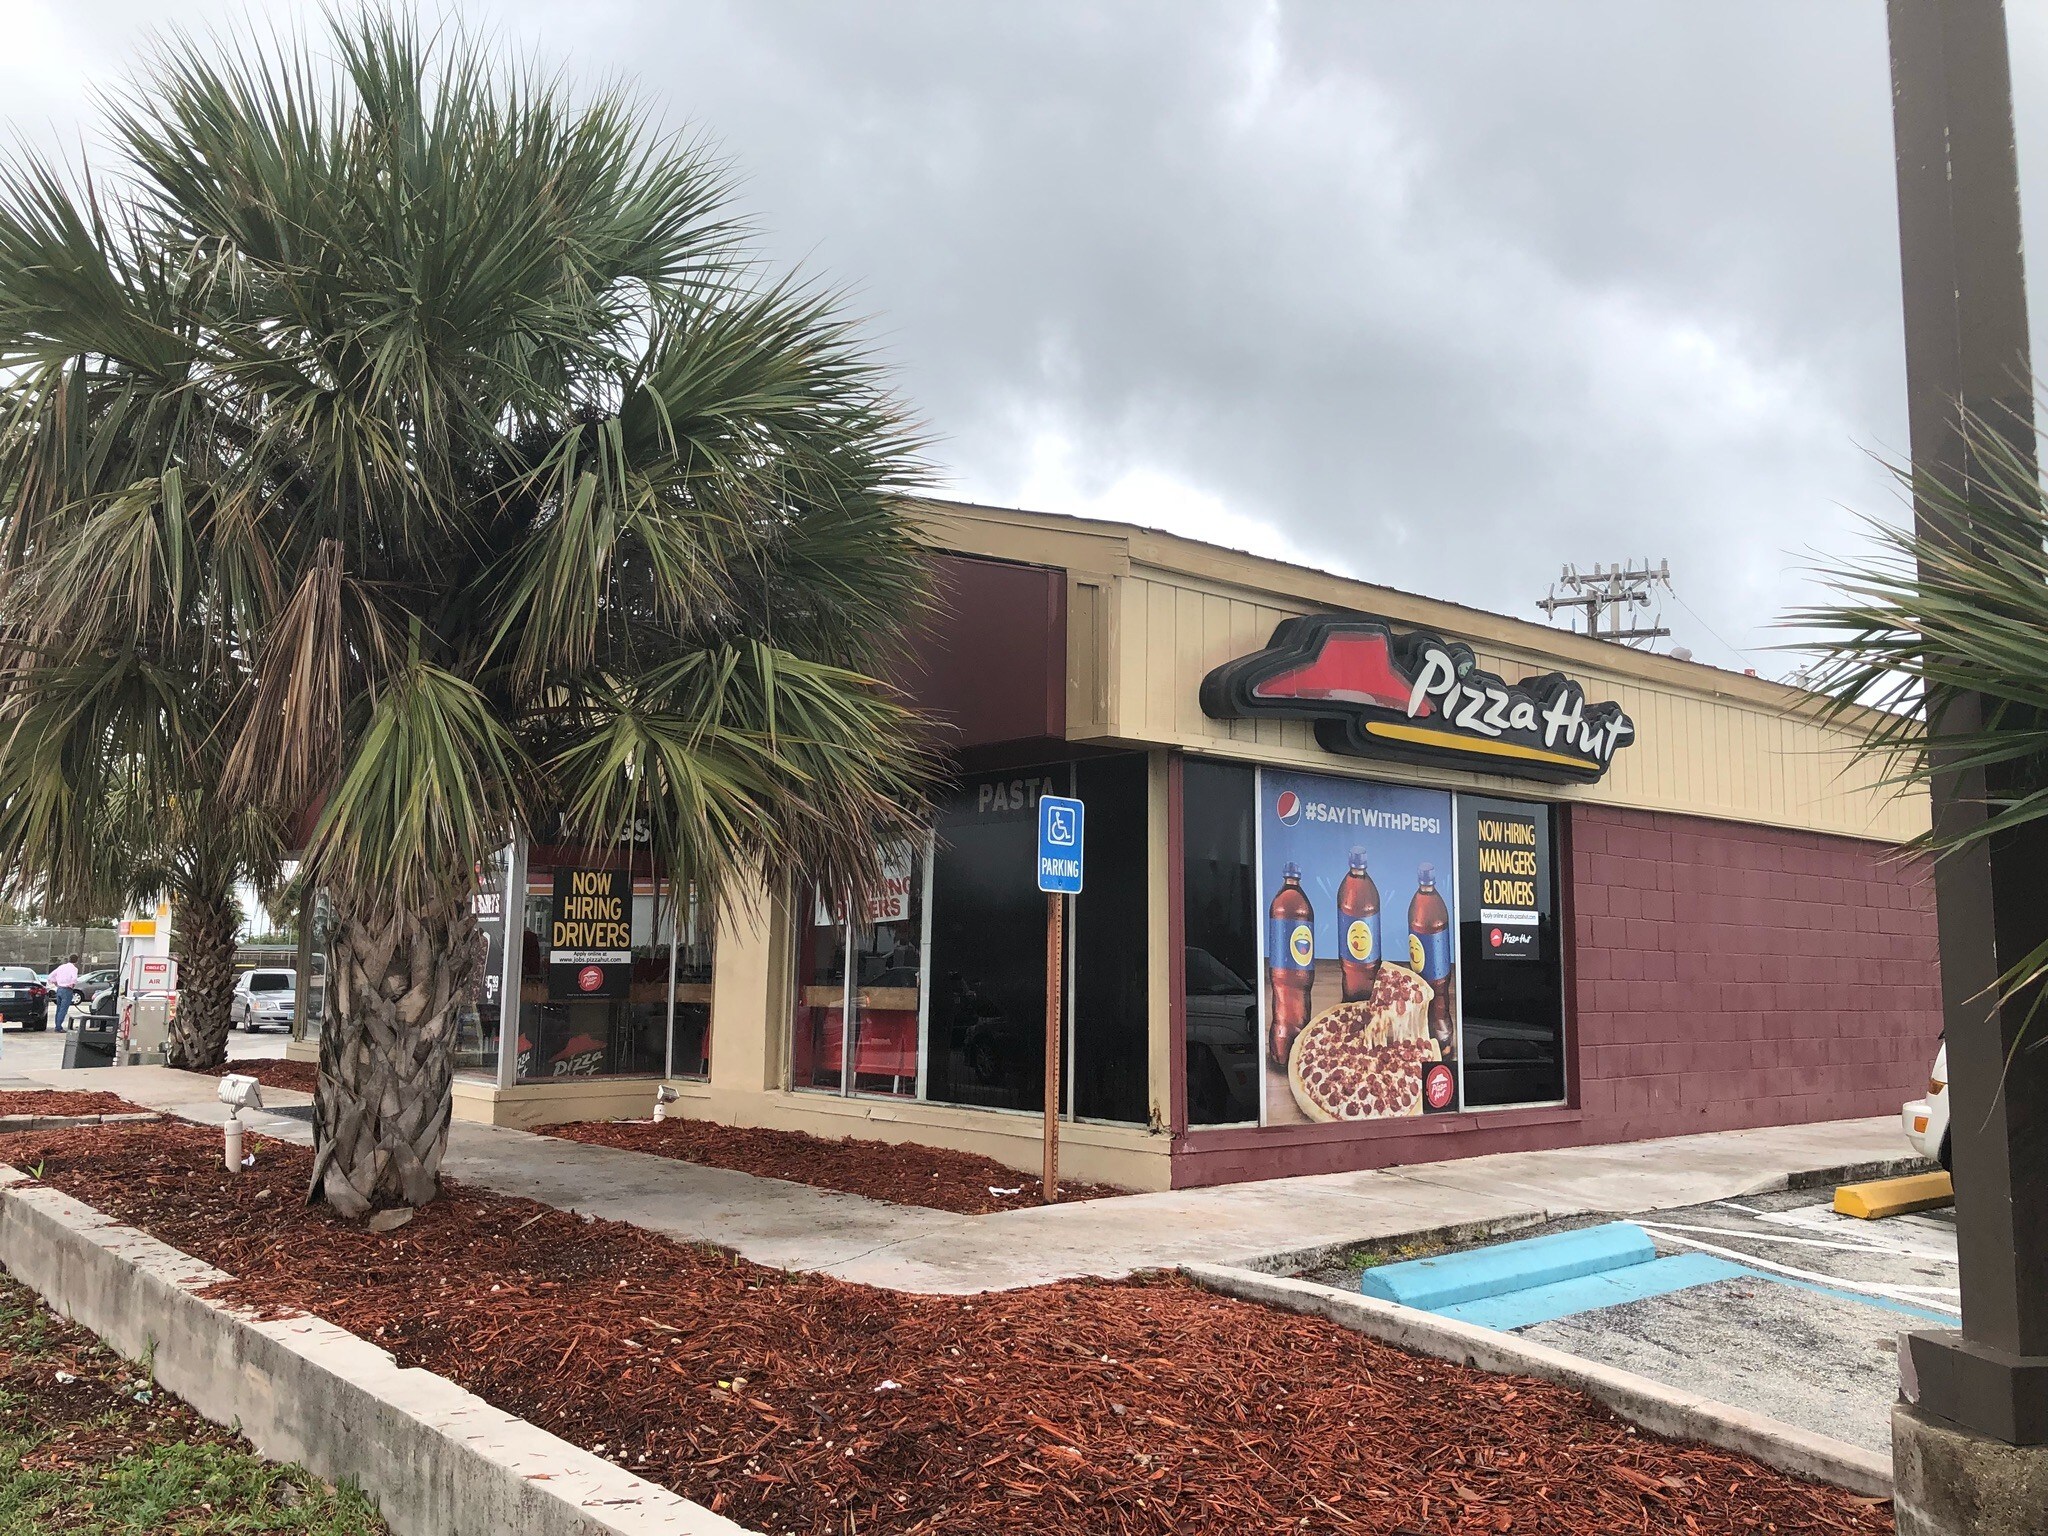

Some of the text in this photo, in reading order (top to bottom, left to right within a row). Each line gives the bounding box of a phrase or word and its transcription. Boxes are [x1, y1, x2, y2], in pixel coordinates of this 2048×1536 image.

[1407, 649, 1634, 761] Pizza Hut
[979, 777, 1054, 812] PASTA
[1305, 802, 1440, 834] #SAYITWITHPEPSI
[1478, 819, 1536, 846] NOW HIRING
[1041, 858, 1079, 878] PARKING
[1480, 848, 1537, 876] MANAGERS
[573, 872, 612, 895] NOW
[1483, 879, 1535, 906] & DRIVERS
[564, 896, 622, 920] HIRING
[553, 922, 631, 947] DRIVERS
[553, 1051, 604, 1077] Pizza
